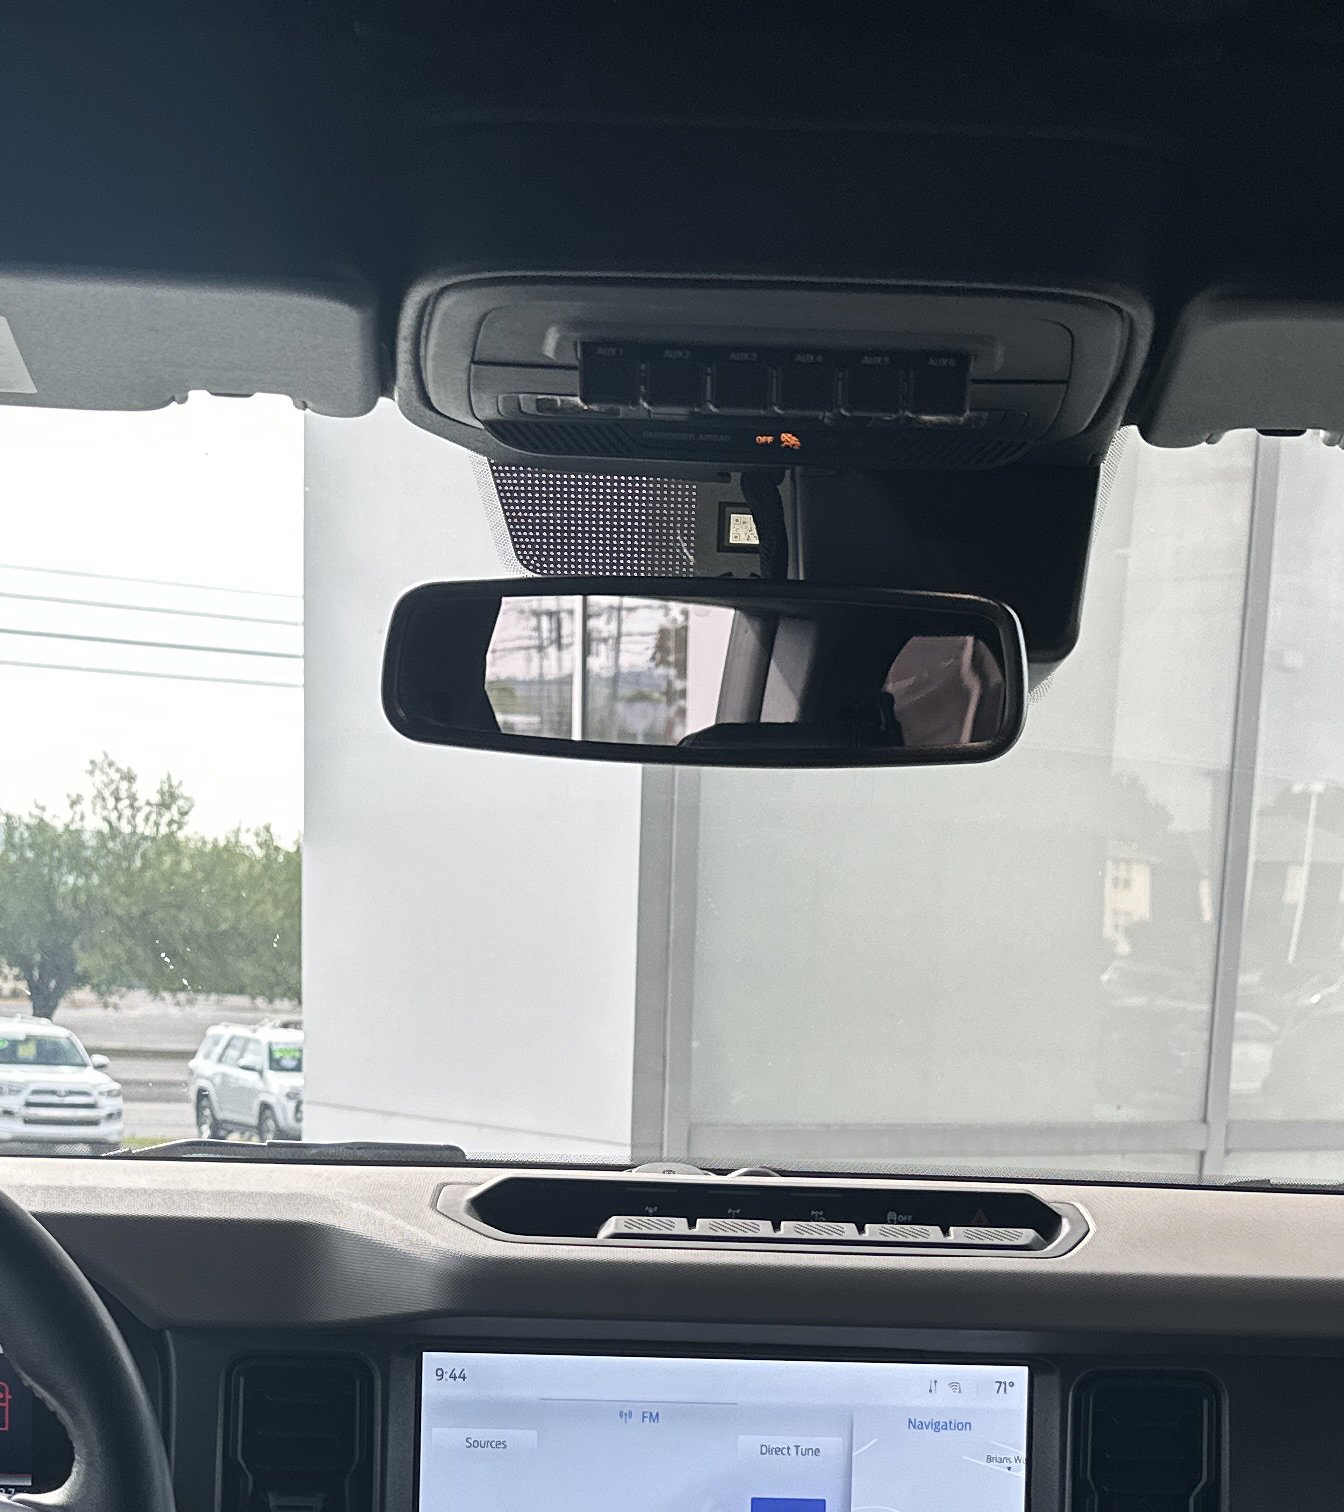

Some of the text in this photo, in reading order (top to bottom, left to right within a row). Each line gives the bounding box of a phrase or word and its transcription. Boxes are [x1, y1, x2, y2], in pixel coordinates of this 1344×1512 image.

[755, 435, 774, 445] OFF
[435, 1367, 467, 1382] 9:44
[994, 1380, 1015, 1394] 71°
[641, 1411, 660, 1423] FM
[907, 1418, 972, 1433] Navigation
[465, 1437, 507, 1450] Sources
[760, 1444, 821, 1457] Direct Tune
